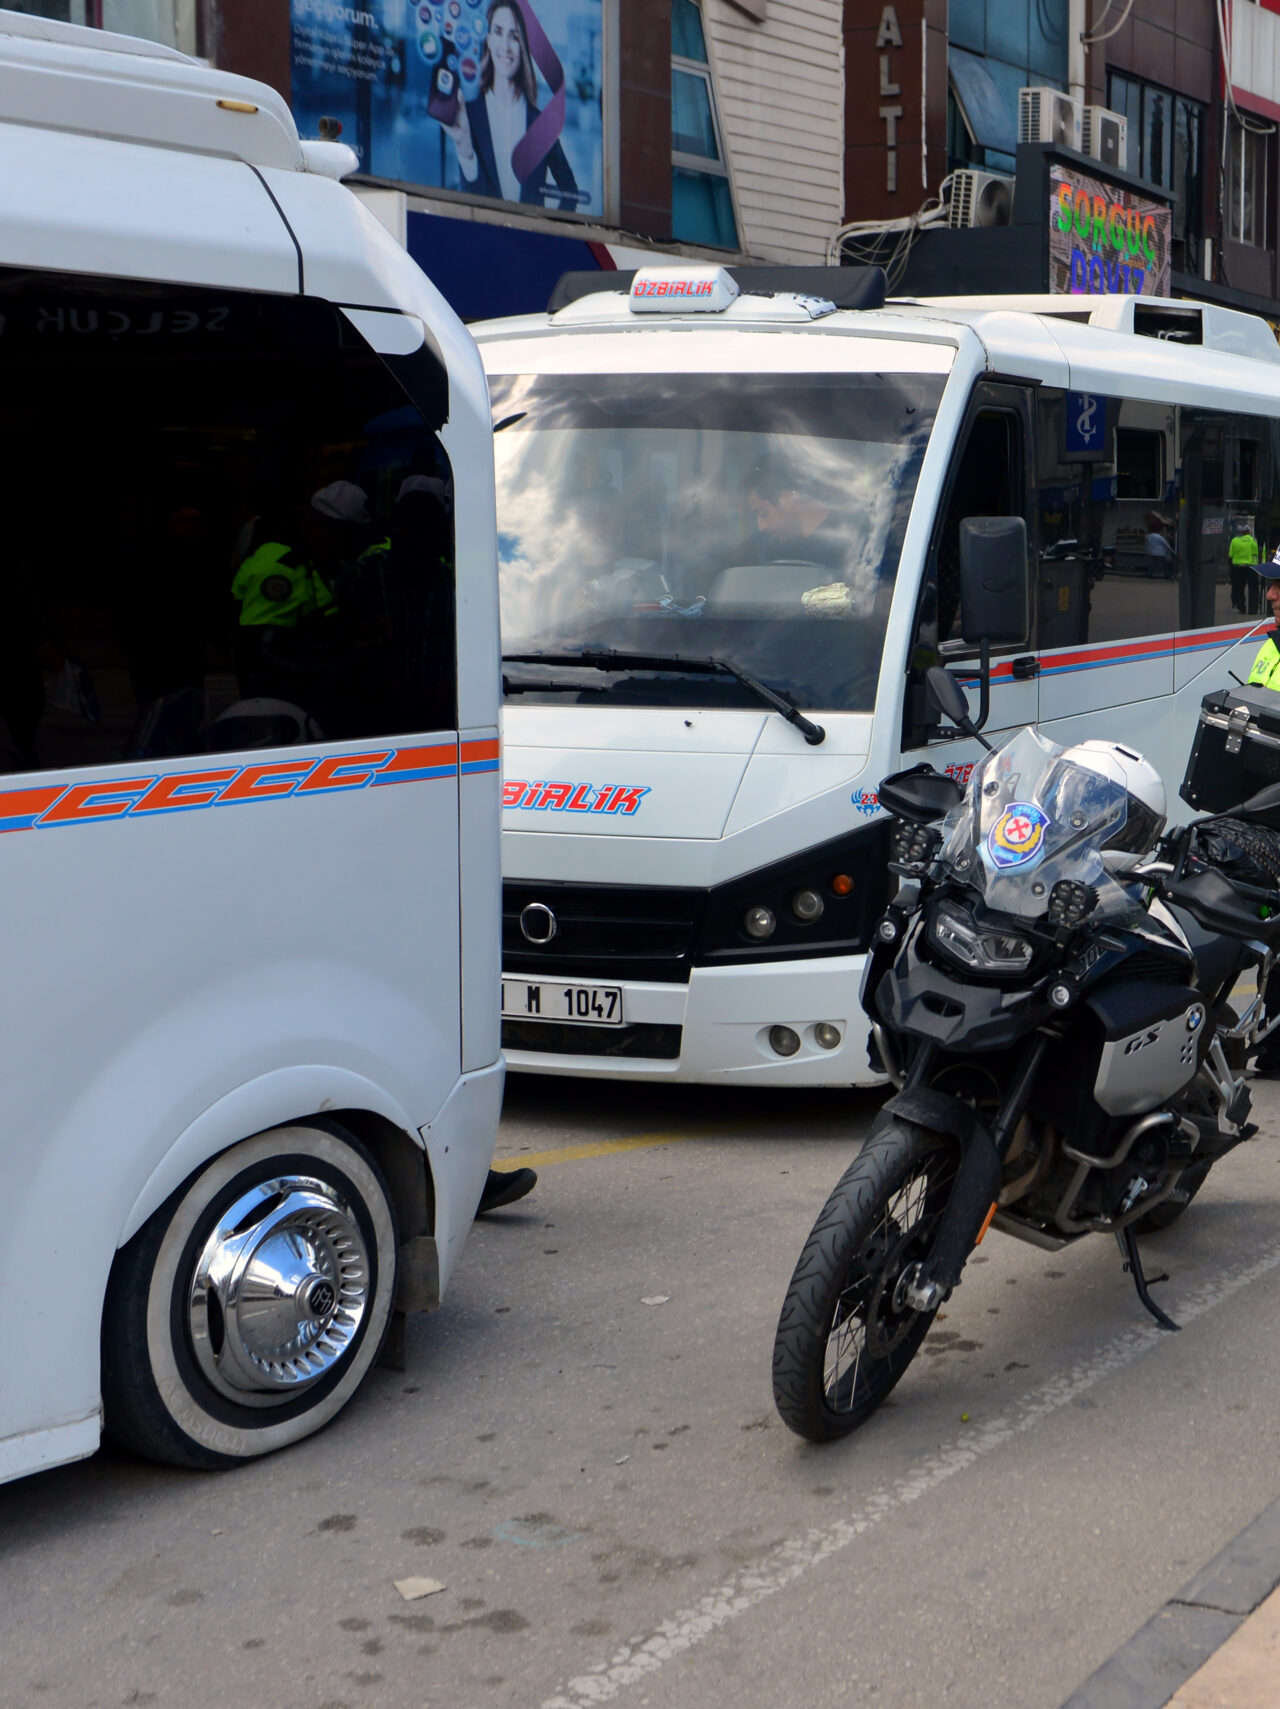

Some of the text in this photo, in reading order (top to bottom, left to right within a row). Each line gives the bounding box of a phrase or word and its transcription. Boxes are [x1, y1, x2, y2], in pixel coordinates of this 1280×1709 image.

[1057, 181, 1156, 271] SORGUÇ
[501, 780, 652, 816] BİRLİK
[860, 793, 878, 805] 23
[527, 986, 541, 1013] M
[563, 988, 618, 1019] 1047
[1124, 1026, 1163, 1055] GS
